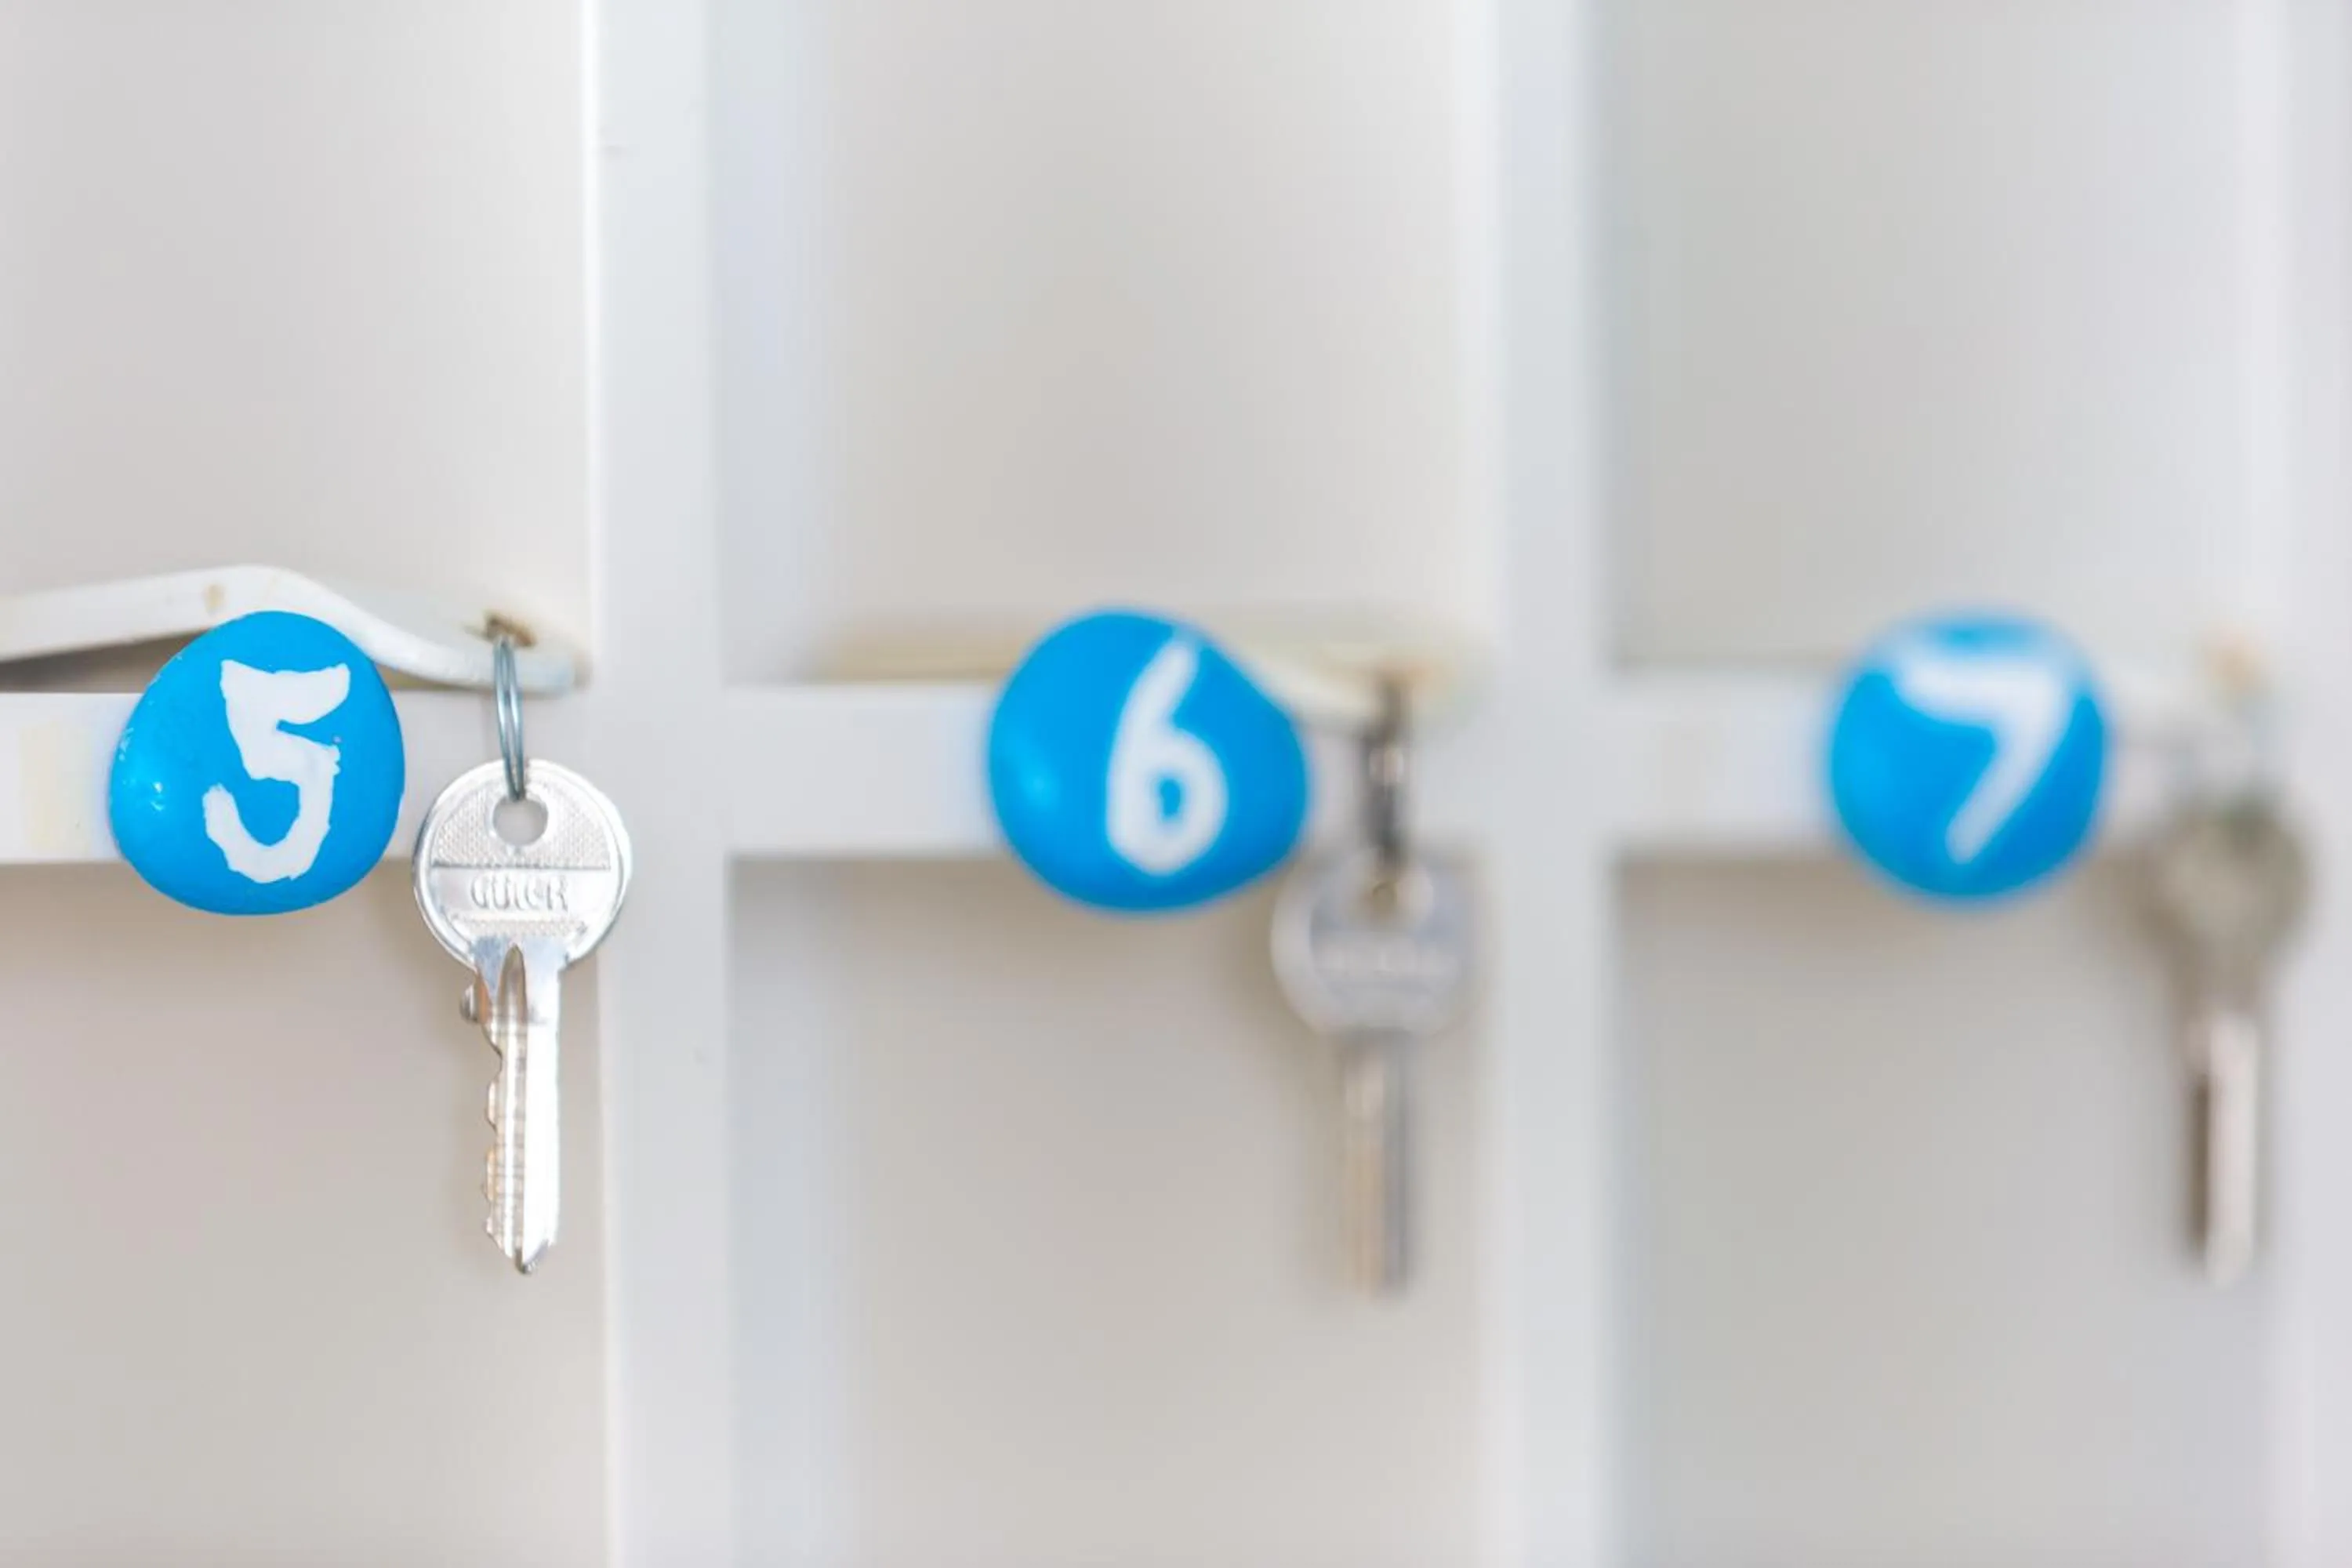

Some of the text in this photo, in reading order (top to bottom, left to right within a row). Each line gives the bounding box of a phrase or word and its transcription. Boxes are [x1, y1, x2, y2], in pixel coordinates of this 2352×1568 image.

[202, 659, 350, 883] 5
[1105, 636, 1229, 873] 6
[1891, 651, 2076, 863] 7
